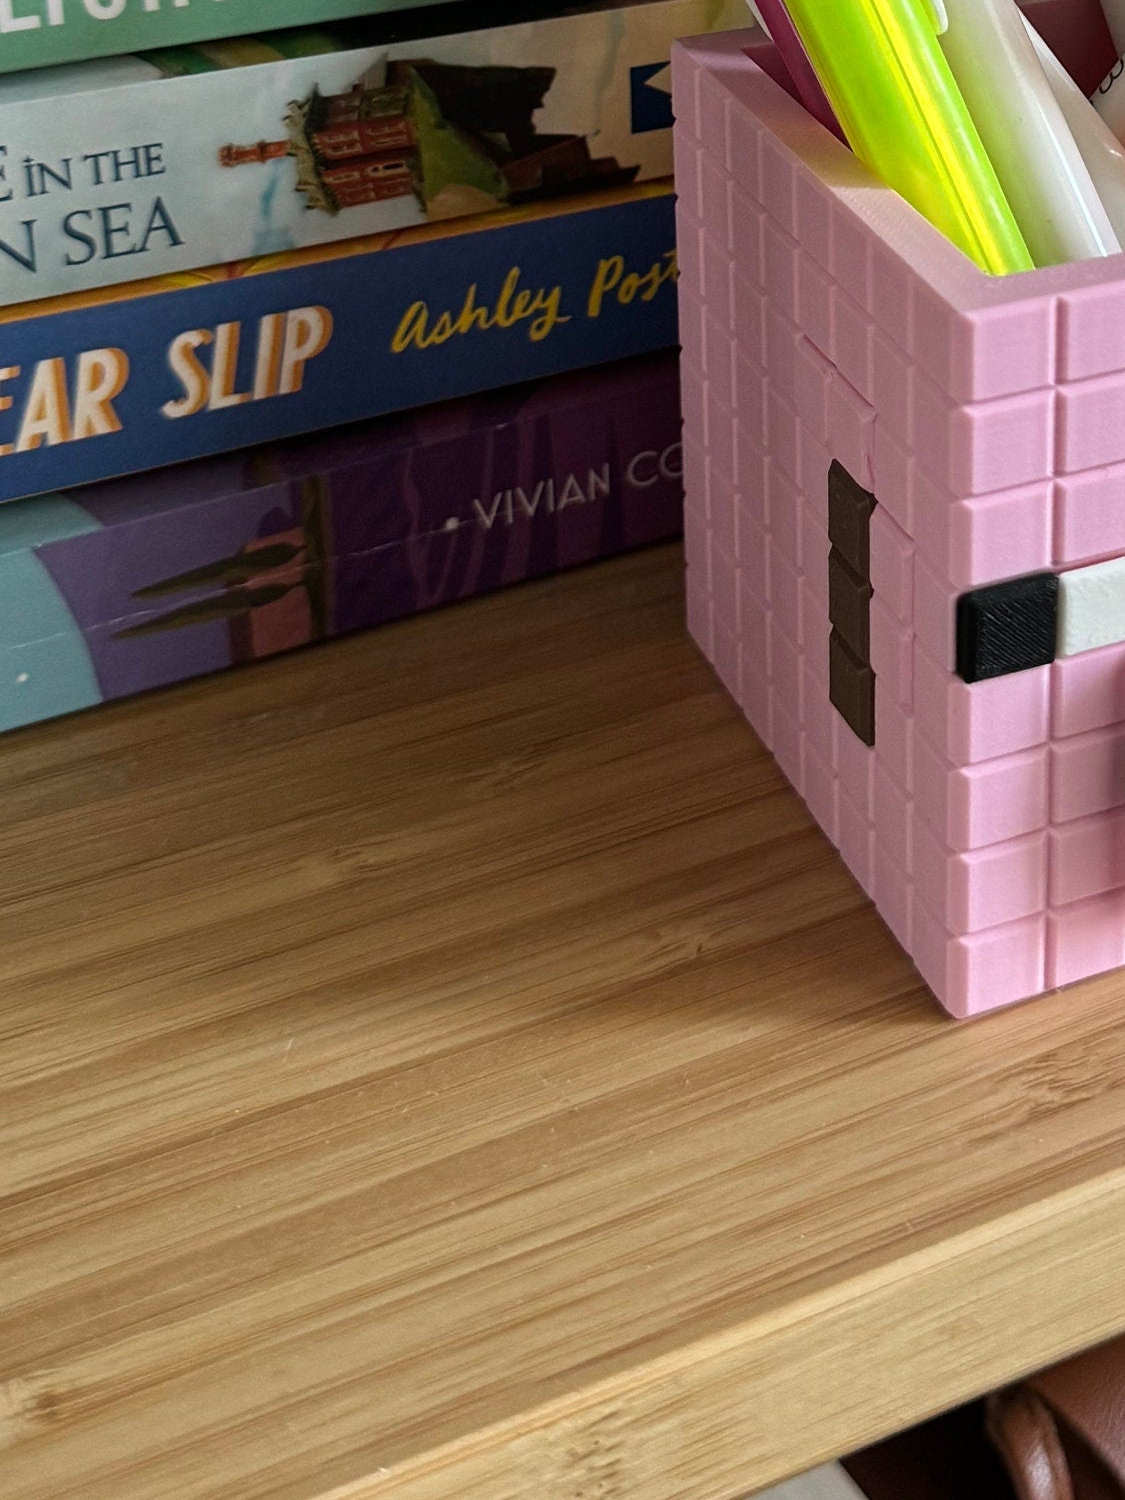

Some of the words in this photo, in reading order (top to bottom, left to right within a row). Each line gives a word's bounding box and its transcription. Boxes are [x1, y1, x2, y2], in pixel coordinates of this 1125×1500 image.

[83, 143, 166, 185] THE
[63, 196, 186, 266] SEA
[390, 266, 572, 352] Ashley
[161, 304, 334, 422] SLIP
[472, 463, 611, 529] VIVIAN
